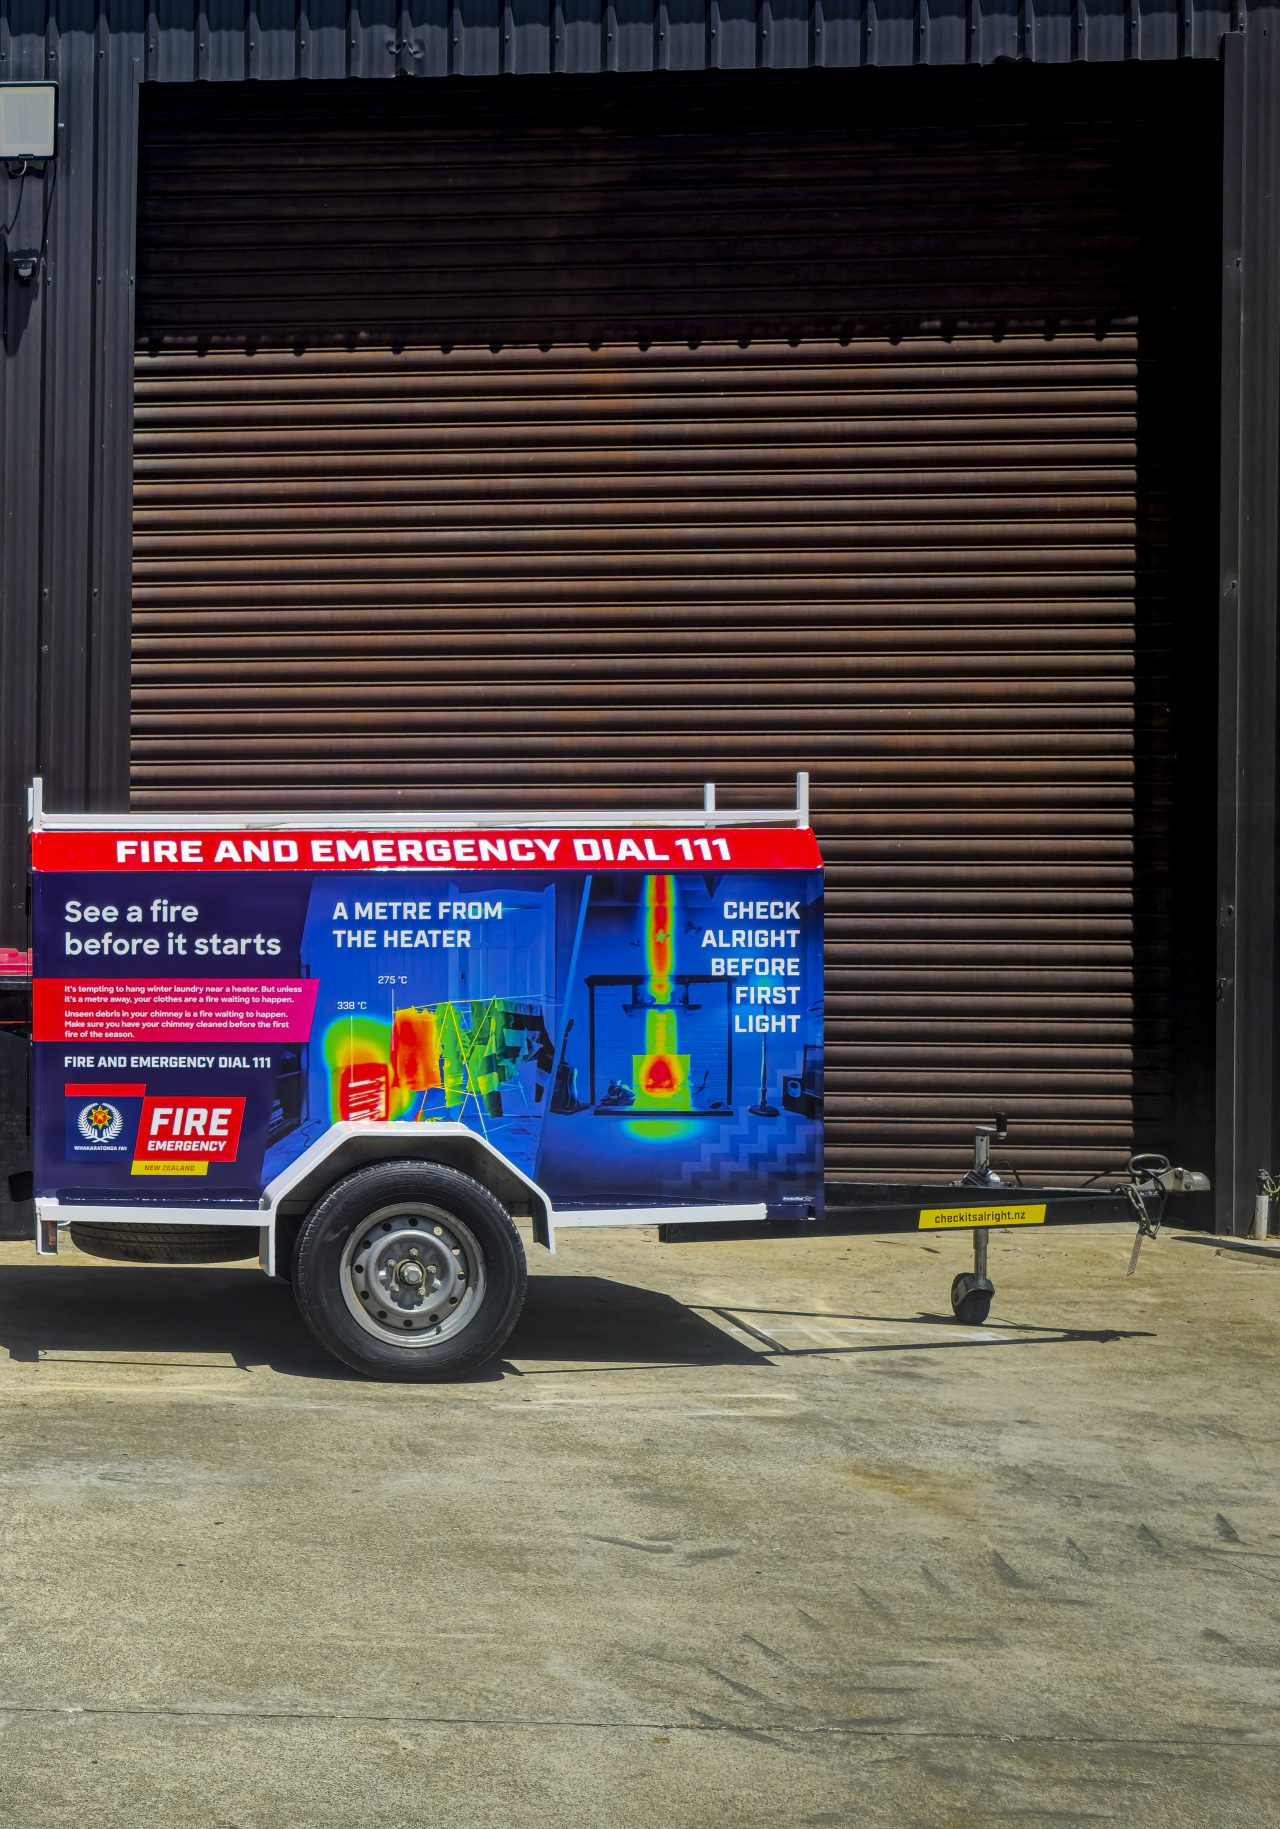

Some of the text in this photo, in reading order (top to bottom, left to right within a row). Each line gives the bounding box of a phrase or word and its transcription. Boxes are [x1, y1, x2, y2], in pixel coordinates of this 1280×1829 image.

[117, 838, 730, 862] FIRE AND EMERGENCY DIAL 111
[65, 899, 198, 922] See a fire
[333, 902, 502, 919] A METRE FROM
[724, 901, 800, 919] CHECK
[66, 932, 281, 955] before it starts
[333, 930, 470, 947] THE HEATER
[701, 930, 800, 947] ALRIGHT
[712, 958, 800, 976] BEFORE
[377, 975, 396, 985] 275
[77, 985, 115, 995] tempting
[115, 985, 125, 993] to
[125, 985, 146, 995] hang
[146, 985, 173, 993] winter
[173, 984, 205, 994] laundry
[231, 985, 260, 993] heater.
[260, 985, 276, 993] But
[276, 985, 303, 993] unless
[736, 987, 800, 1004] FIRST
[84, 995, 109, 1003] metre
[109, 995, 133, 1005] away,
[133, 996, 152, 1005] your
[152, 995, 183, 1003] clothes
[204, 995, 220, 1003] fire
[220, 995, 251, 1005] waiting
[261, 995, 295, 1005] happen.
[336, 1001, 356, 1010] 338
[64, 1010, 95, 1018] Unseen
[95, 1009, 121, 1018] debris
[121, 1009, 130, 1018] in
[129, 1011, 149, 1020] your
[149, 1009, 184, 1019] chimney
[184, 1010, 192, 1018] is
[199, 1009, 214, 1018] fire
[214, 1010, 245, 1020] waiting
[245, 1010, 255, 1018] to
[255, 1010, 289, 1020] happen.
[64, 1020, 86, 1028] Make
[105, 1021, 121, 1030] you
[121, 1020, 141, 1028] have
[141, 1021, 160, 1030] your
[160, 1020, 195, 1030] chimney
[195, 1020, 229, 1028] cleaned
[228, 1020, 257, 1028] before
[257, 1020, 273, 1028] the
[272, 1020, 290, 1028] first
[735, 1015, 800, 1032] LIGHT
[64, 1030, 79, 1038] fire
[79, 1030, 89, 1038] of
[89, 1030, 104, 1038] the
[64, 1055, 271, 1069] FIRE AND EMERGENCY DIAL 111
[150, 1108, 232, 1136] FIRE
[147, 1140, 227, 1152] EMERGENCY
[161, 1164, 195, 1172] ZEALAND
[934, 1210, 1026, 1223] checkitsalright.nz
